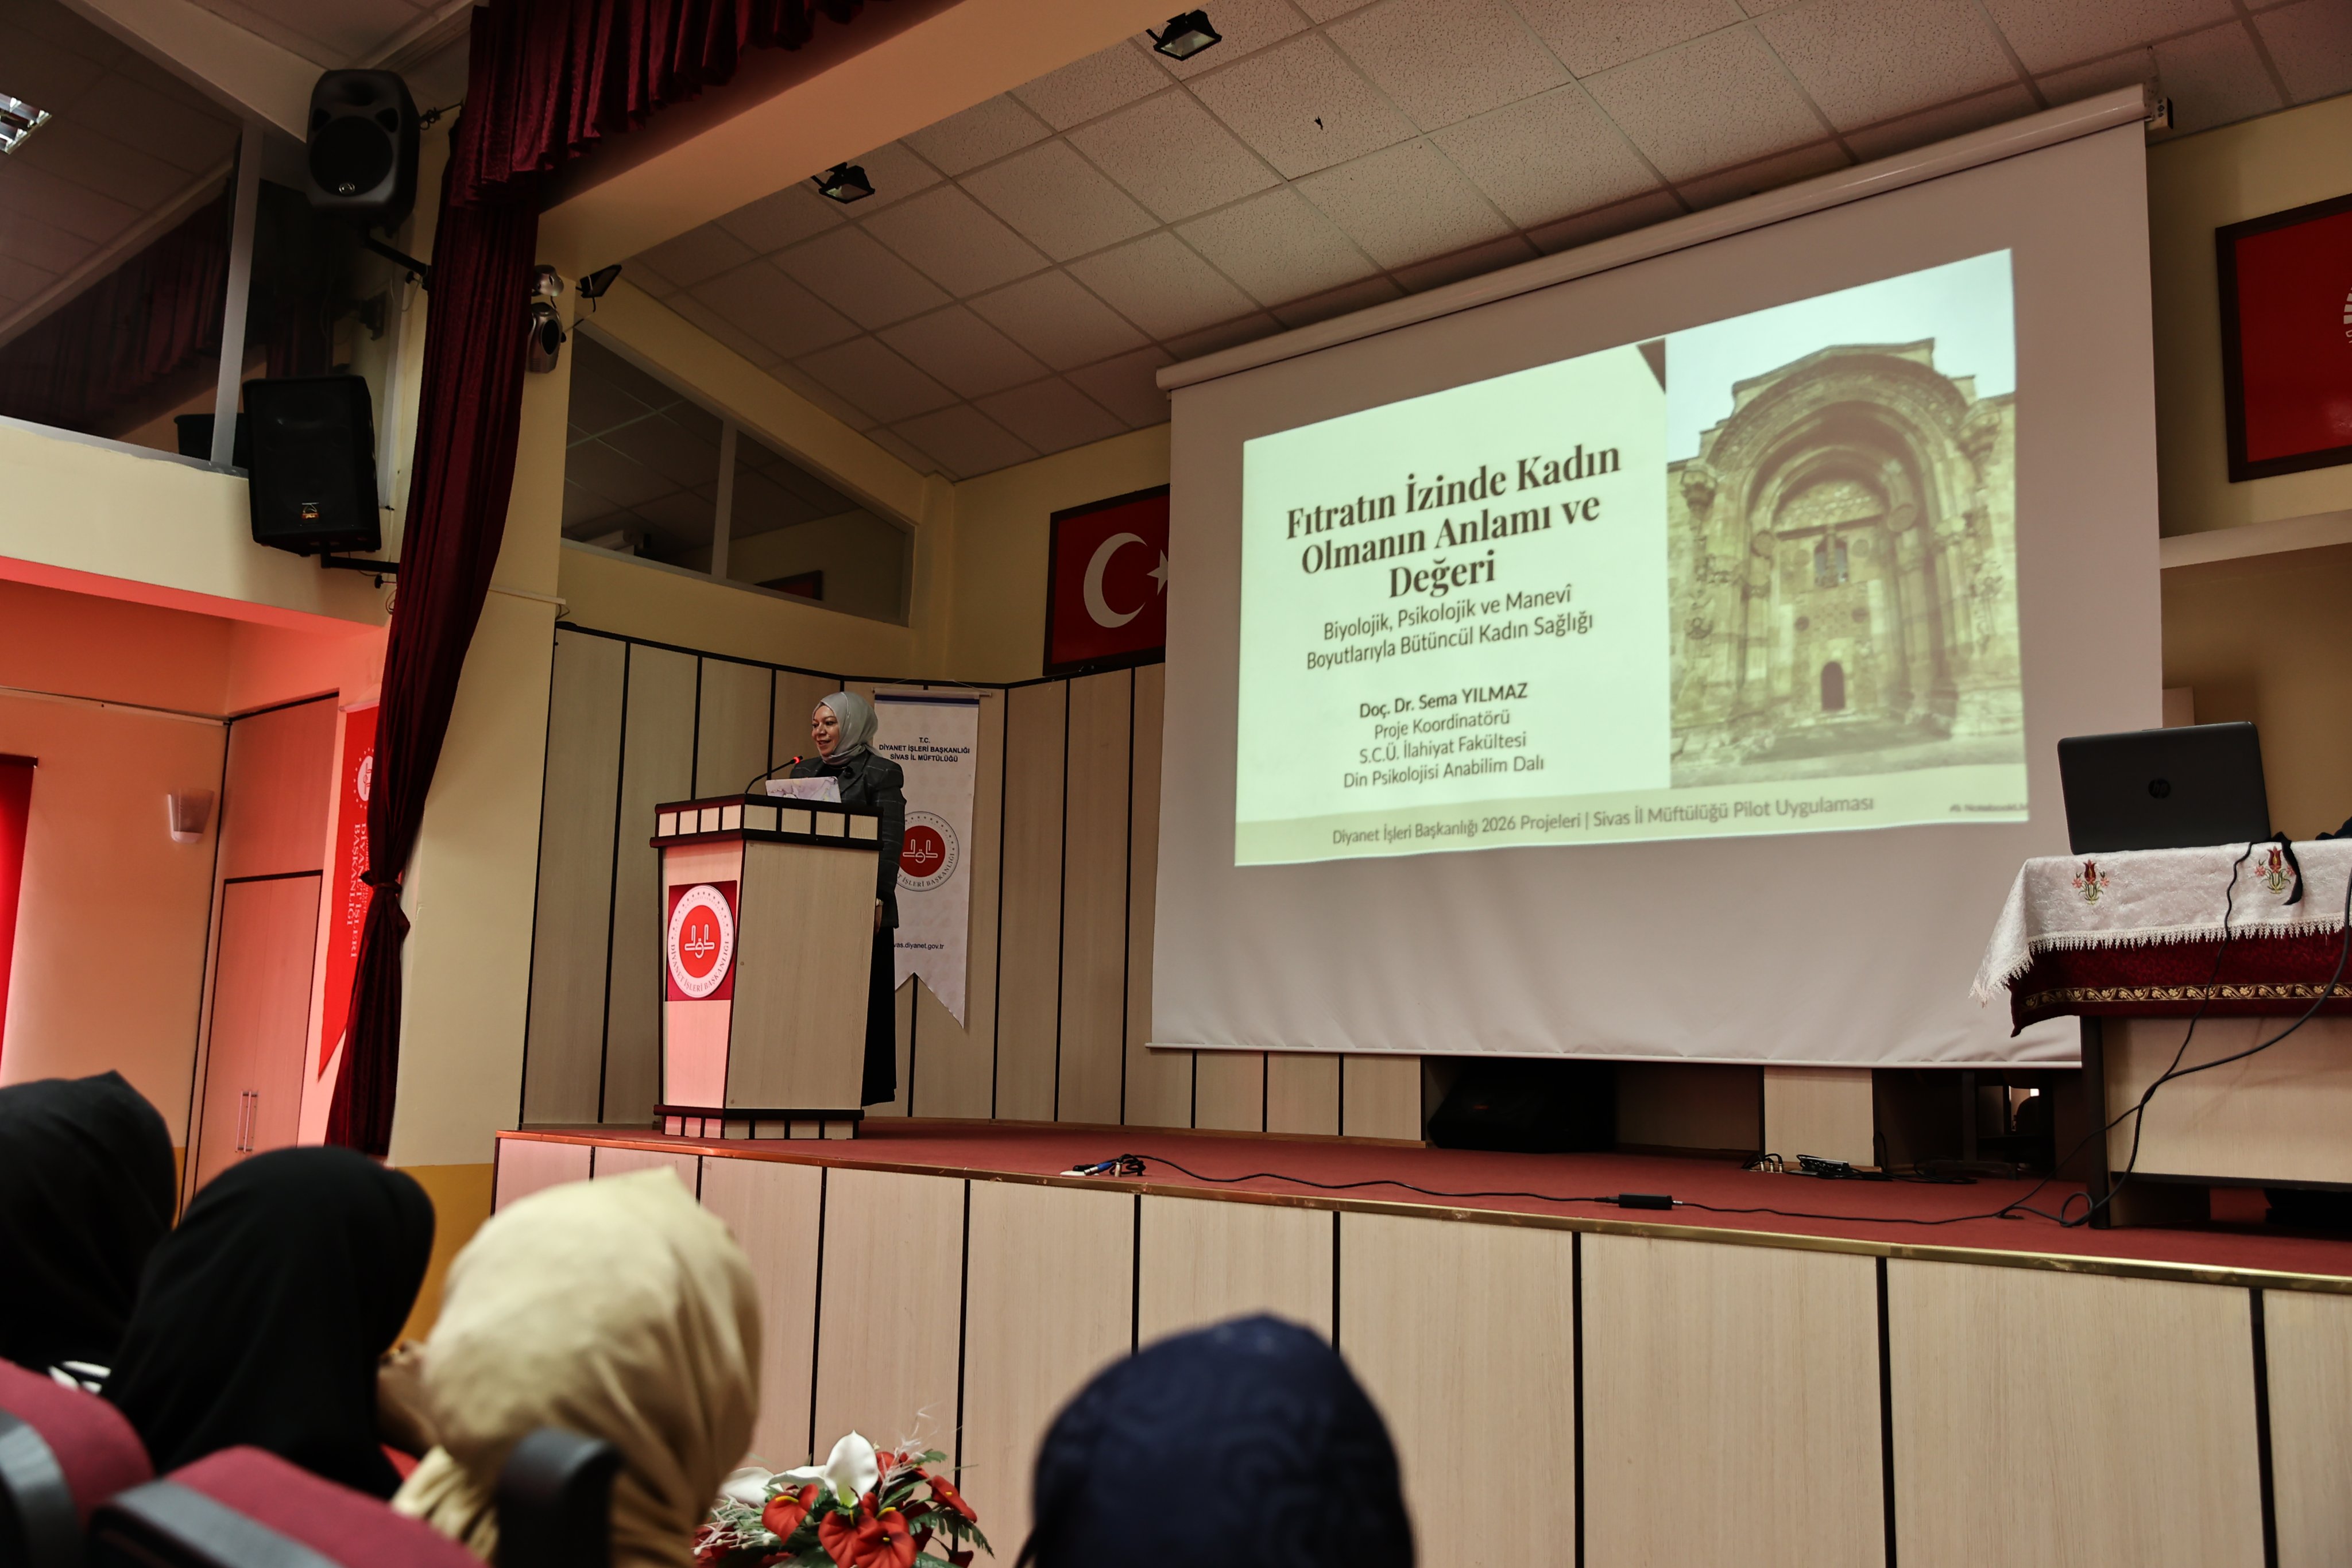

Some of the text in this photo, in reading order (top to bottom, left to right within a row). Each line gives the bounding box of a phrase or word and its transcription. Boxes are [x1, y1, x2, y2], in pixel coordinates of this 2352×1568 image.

[1286, 444, 1621, 540] Fıtratın İzinde Kadın
[1302, 496, 1601, 574] Olmanın Anlamı ve
[1388, 549, 1496, 599] Değeri
[1324, 583, 1572, 641] Biyolojik, Psikolojik ve Manevî
[1307, 609, 1593, 670] Boyutlarıyla Bütüncül Kadın Sağlığı
[1359, 682, 1528, 719] Doç. Dr. Sema YILMAZ
[1375, 710, 1511, 740] Proje Koordinatörü
[879, 744, 970, 754] DİYANET İŞLERİ BAŞKANLIĞI
[918, 754, 958, 762] MÜFTÜLÜĞÜ
[1359, 731, 1527, 764] S.C.Ü. İlahiyat Fakültesi
[1344, 754, 1544, 788] Din Psikolojisi Anabilim Dalı
[1332, 827, 1380, 846] Diyanet
[1383, 823, 1412, 843] İşleri
[1415, 818, 1478, 839] Başkanlığı
[1481, 816, 1516, 833] 2026
[1520, 812, 1581, 833] Projeleri
[1593, 809, 1630, 828] Sivas
[1634, 804, 1644, 824] İl
[1648, 802, 1729, 824] Müftülüğü
[1733, 799, 1771, 819] Pilot
[1775, 796, 1875, 819] Uygulaması
[902, 853, 955, 887] İŞLERİ BAŞKANLIĞI
[670, 941, 730, 992] DİYANET İŞLERİ BAŞKANLIĞI
